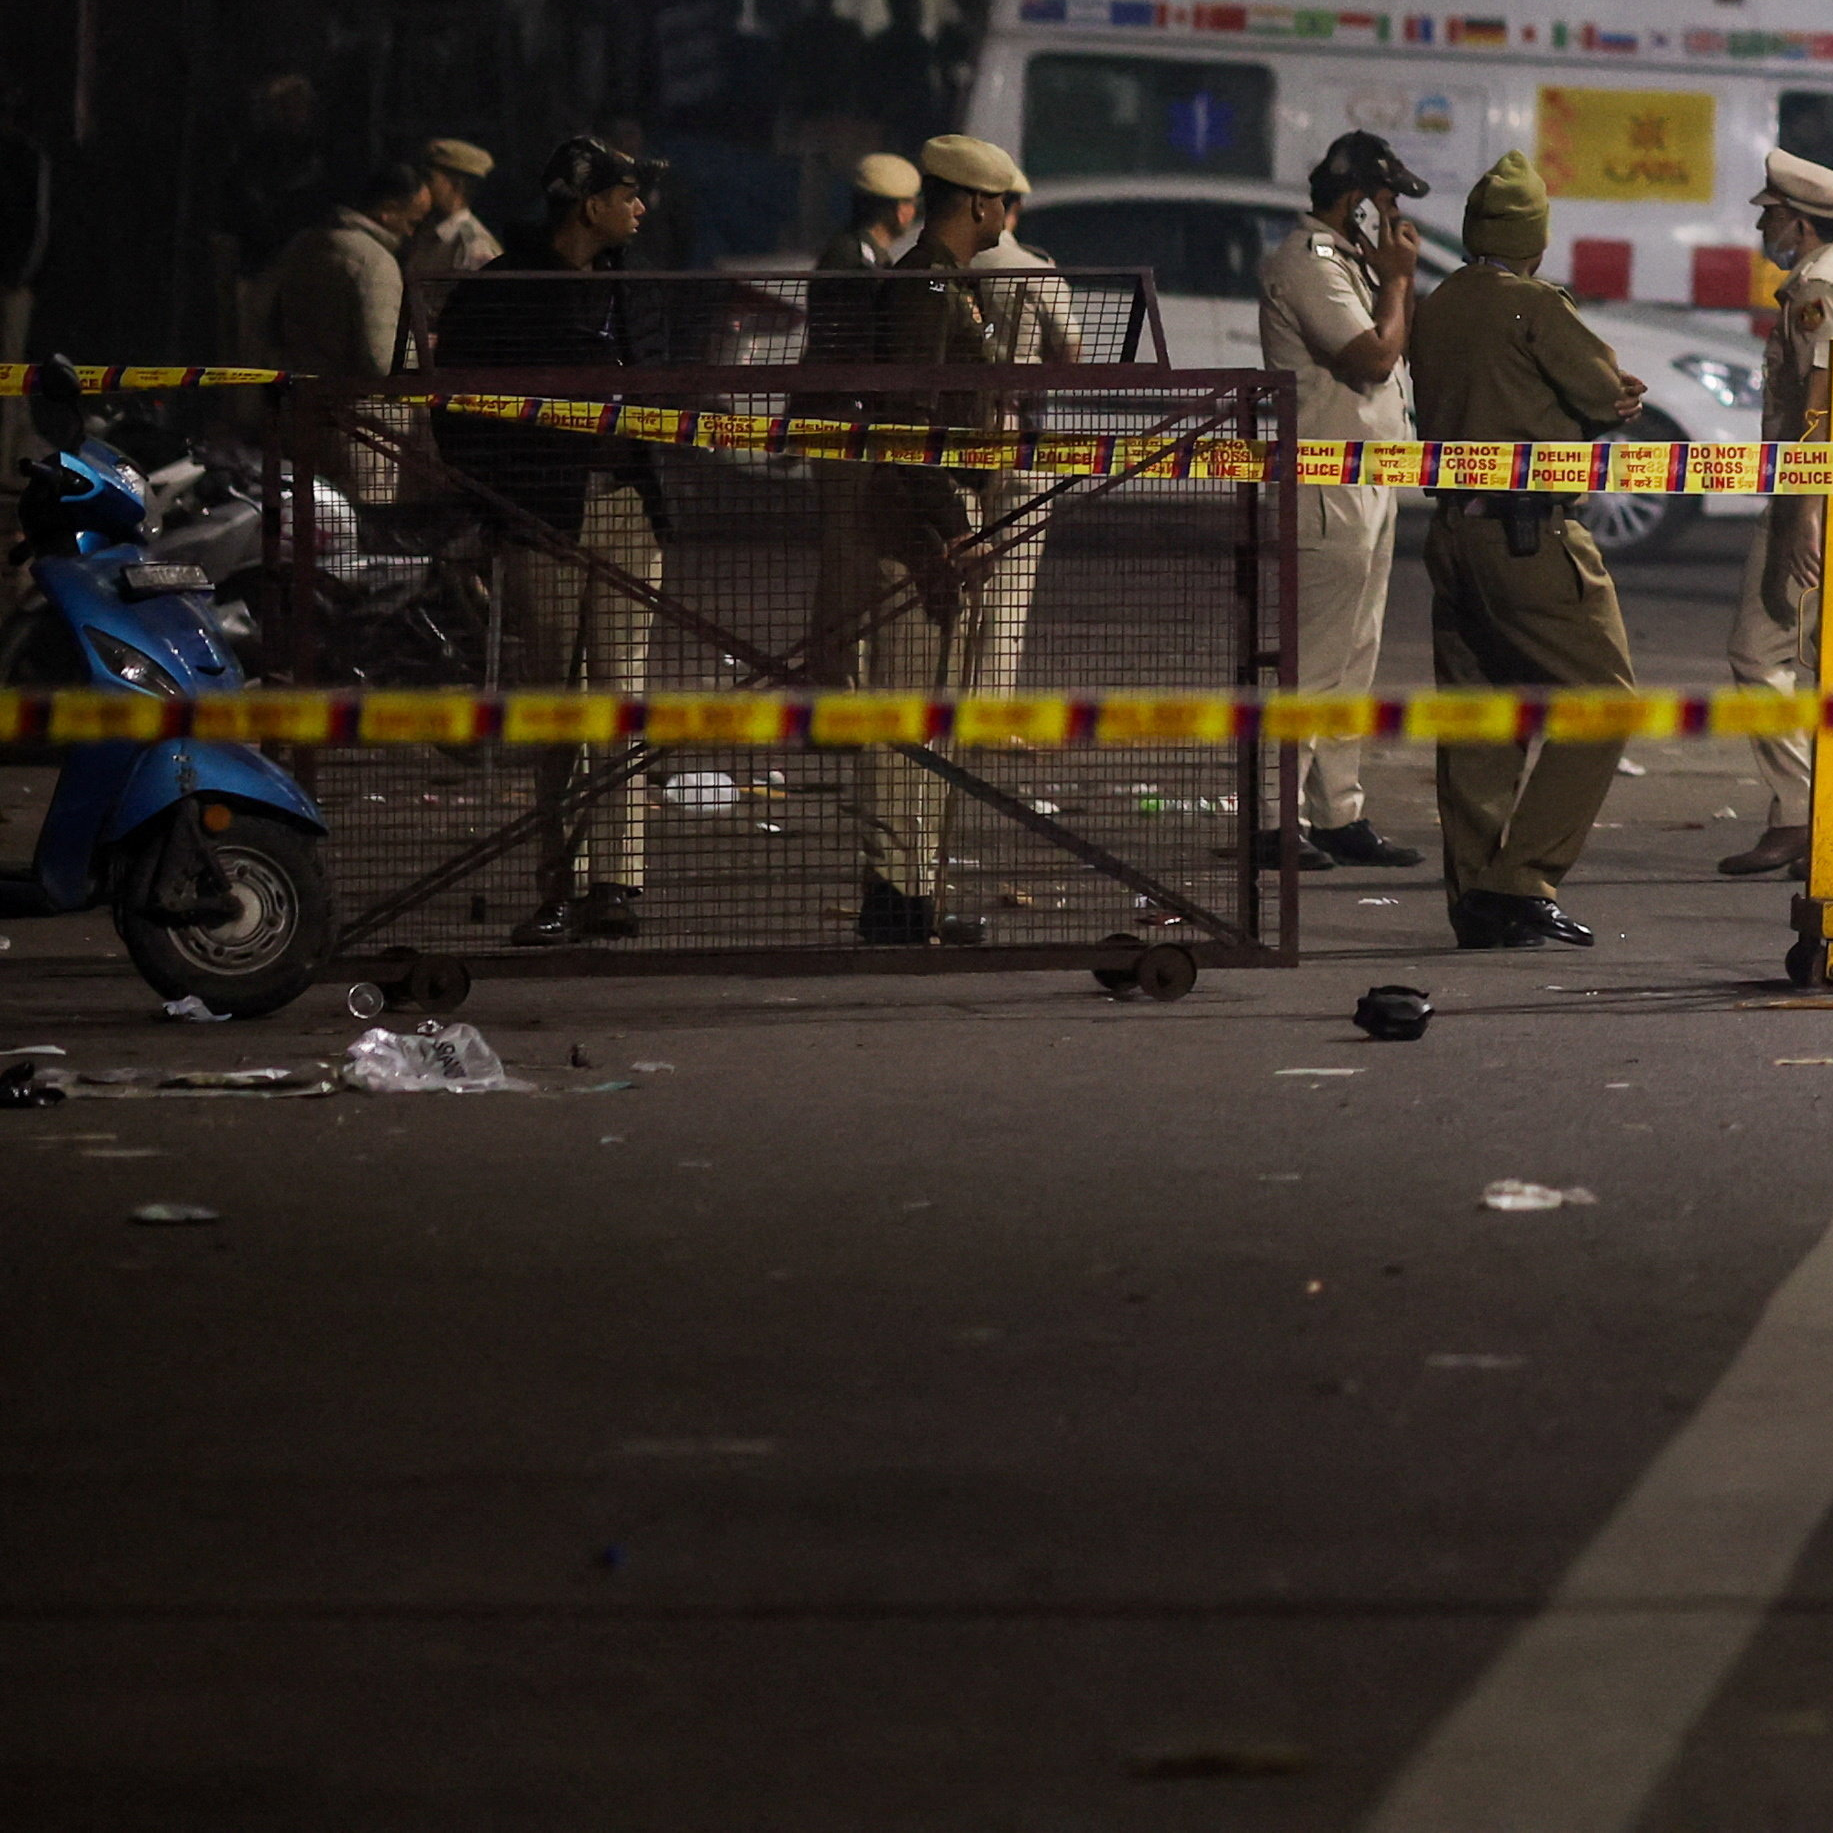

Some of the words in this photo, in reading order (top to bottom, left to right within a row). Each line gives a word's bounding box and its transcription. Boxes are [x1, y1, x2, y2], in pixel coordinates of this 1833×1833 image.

[1444, 447, 1464, 455] DO
[1469, 447, 1500, 456] NOT
[1537, 451, 1581, 462] DELHI
[1691, 447, 1710, 459] DO
[1716, 447, 1747, 459] NOT
[1379, 459, 1399, 468] पार
[1446, 458, 1496, 470] CROSS
[1784, 452, 1827, 464] DELHI
[1296, 463, 1339, 476] OLICE
[1626, 464, 1646, 473] पार
[1693, 461, 1743, 474] CROSS
[1372, 474, 1382, 485] न
[1455, 472, 1488, 485] LINE
[1532, 469, 1586, 482] POLICE
[1779, 472, 1832, 484] POLICE
[1620, 479, 1630, 487] न
[1702, 476, 1734, 489] LINE
